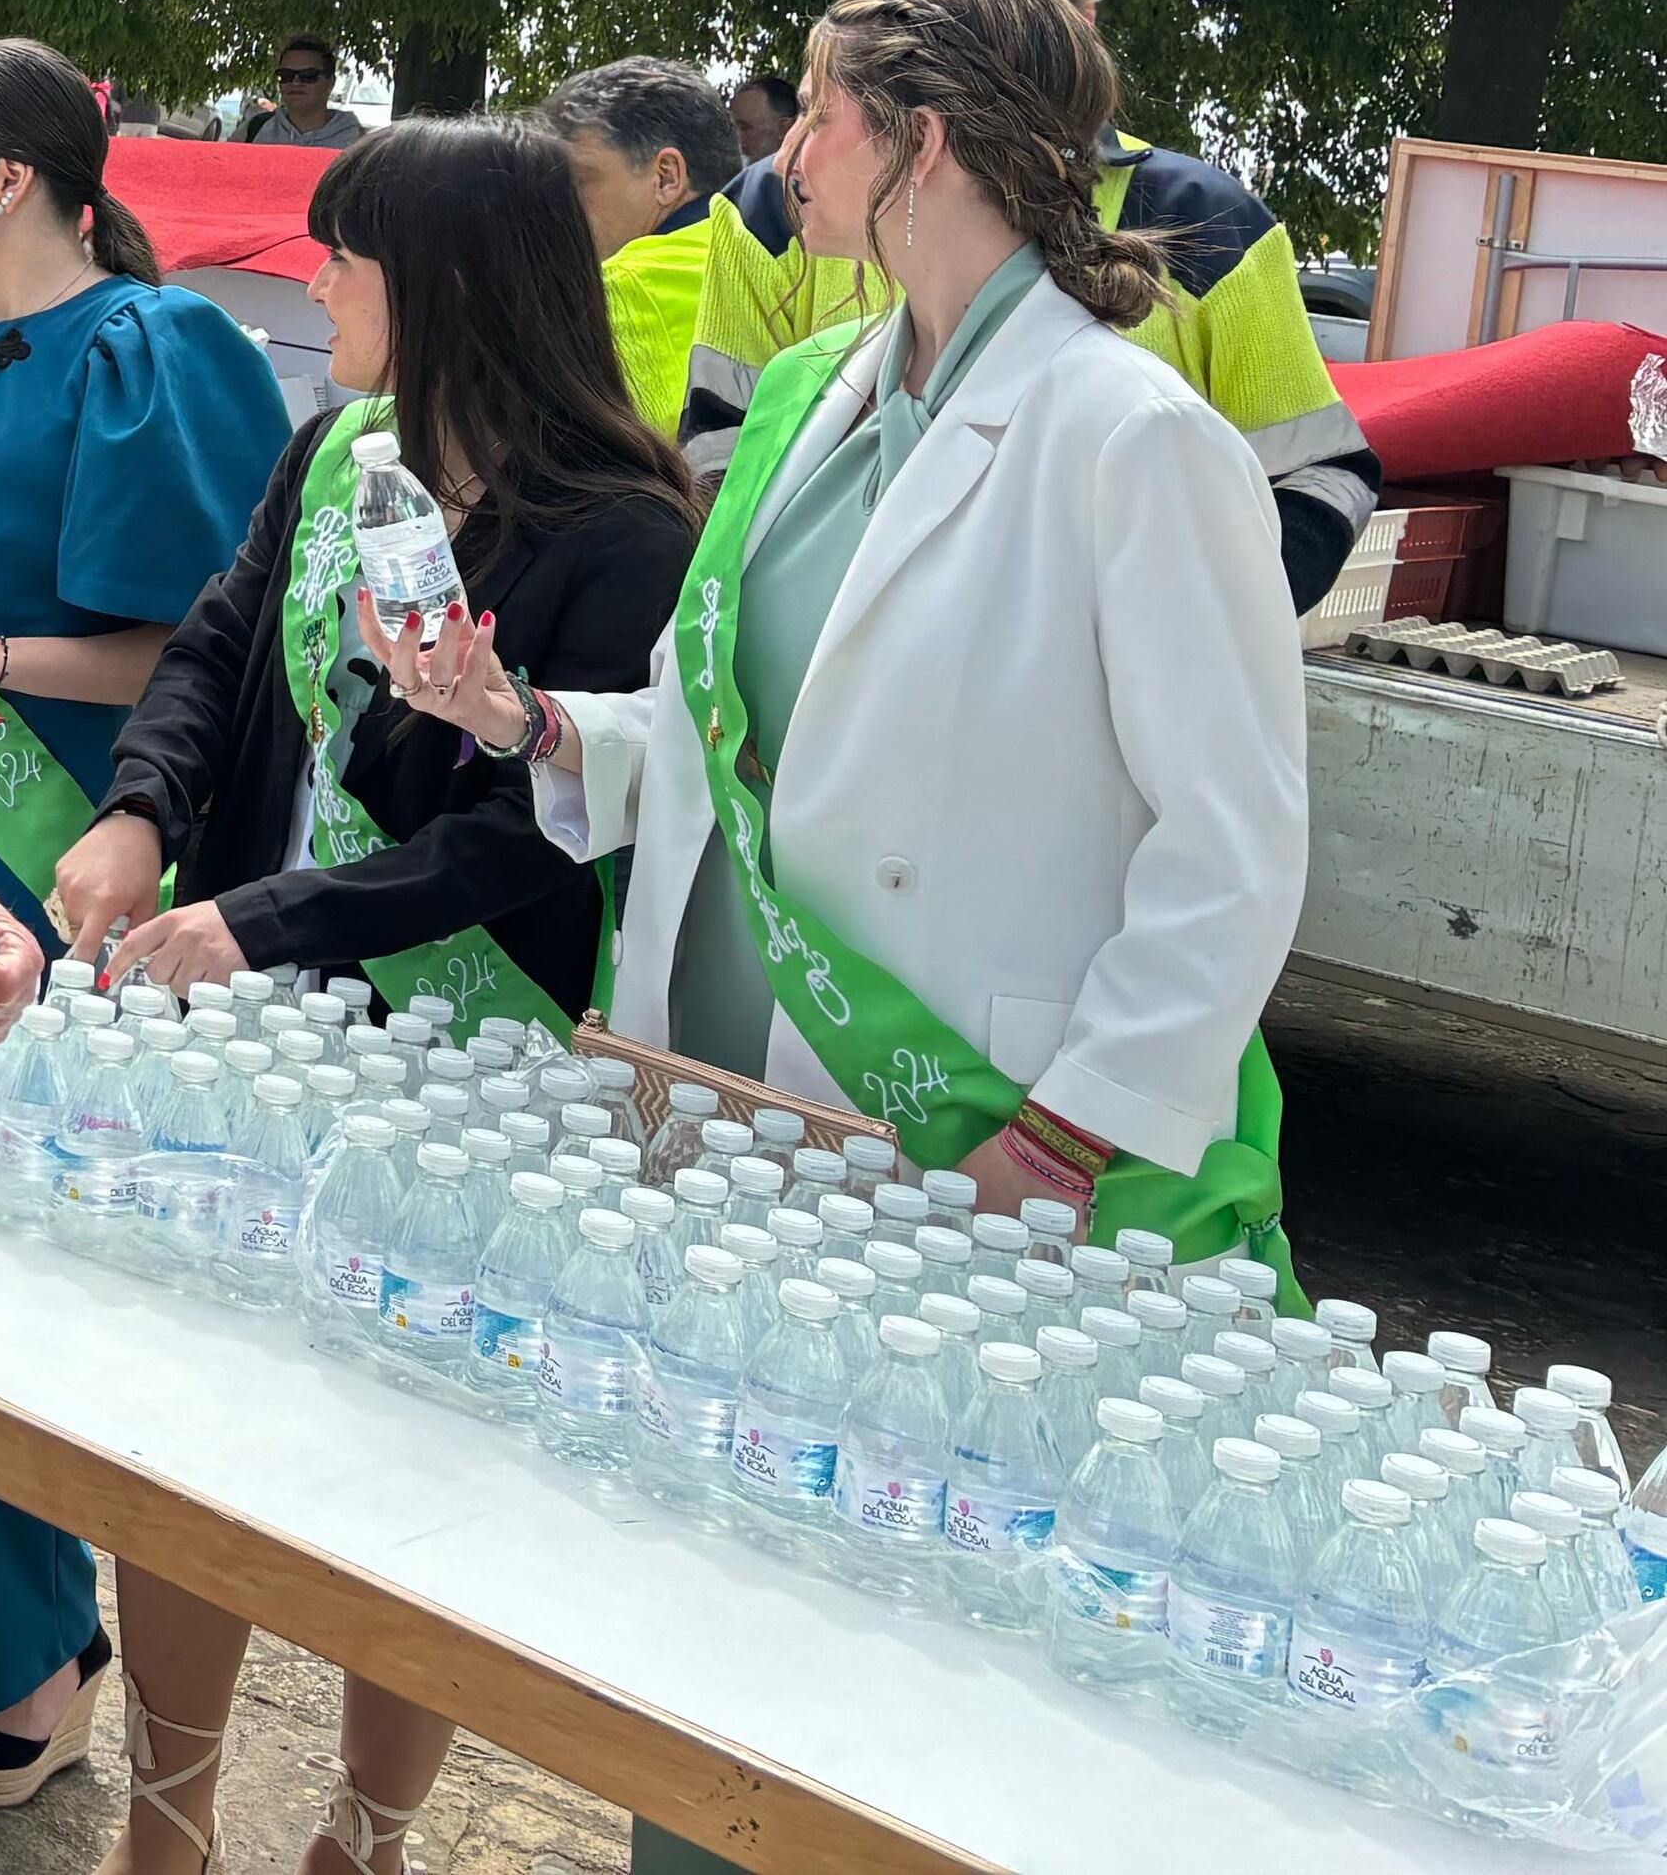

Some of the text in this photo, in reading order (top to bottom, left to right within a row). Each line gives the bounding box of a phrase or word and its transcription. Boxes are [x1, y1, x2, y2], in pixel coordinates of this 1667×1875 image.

[863, 1048, 950, 1124] 2024
[241, 1232, 259, 1245] DEL
[252, 1225, 280, 1238] AGUA
[329, 1278, 347, 1292] DEL
[339, 1272, 368, 1285] AGUA
[742, 1444, 767, 1464] AGUA
[746, 1458, 777, 1479] ROSAL
[862, 1503, 882, 1519] DEL
[876, 1498, 910, 1514] AGUA
[953, 1516, 979, 1534] AGUA
[958, 1530, 991, 1549] ROSAL
[1310, 1665, 1344, 1687] AGUA
[1298, 1671, 1316, 1689] DEL
[1317, 1679, 1357, 1704] ROSAL
